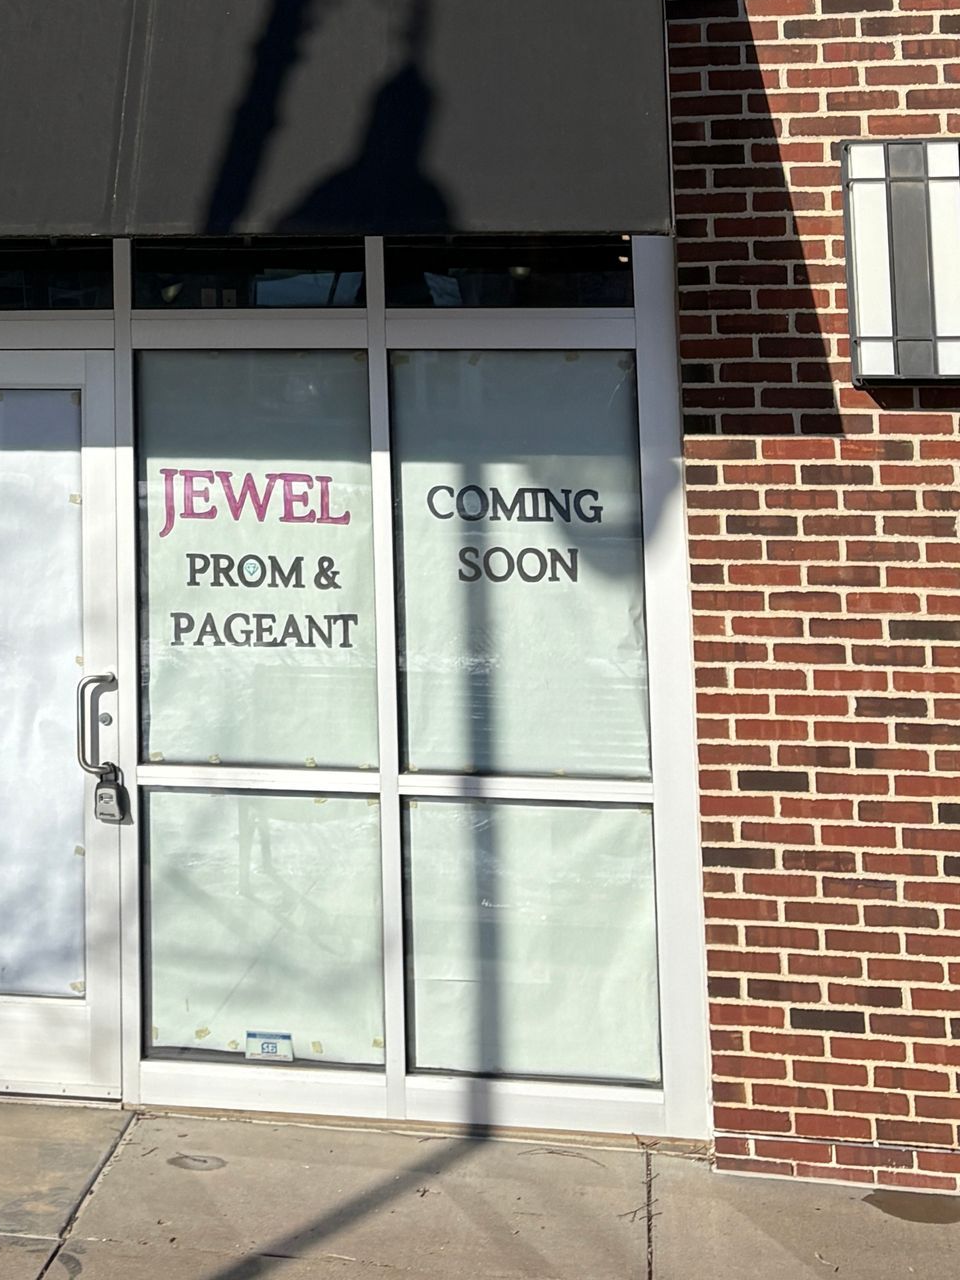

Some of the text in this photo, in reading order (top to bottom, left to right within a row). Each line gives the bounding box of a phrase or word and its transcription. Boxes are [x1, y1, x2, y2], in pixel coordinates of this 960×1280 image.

[159, 467, 351, 538] JEWEL
[427, 485, 603, 524] COMING
[186, 553, 342, 589] PROM &
[458, 546, 579, 583] SOON
[170, 612, 358, 649] PAGEANT
